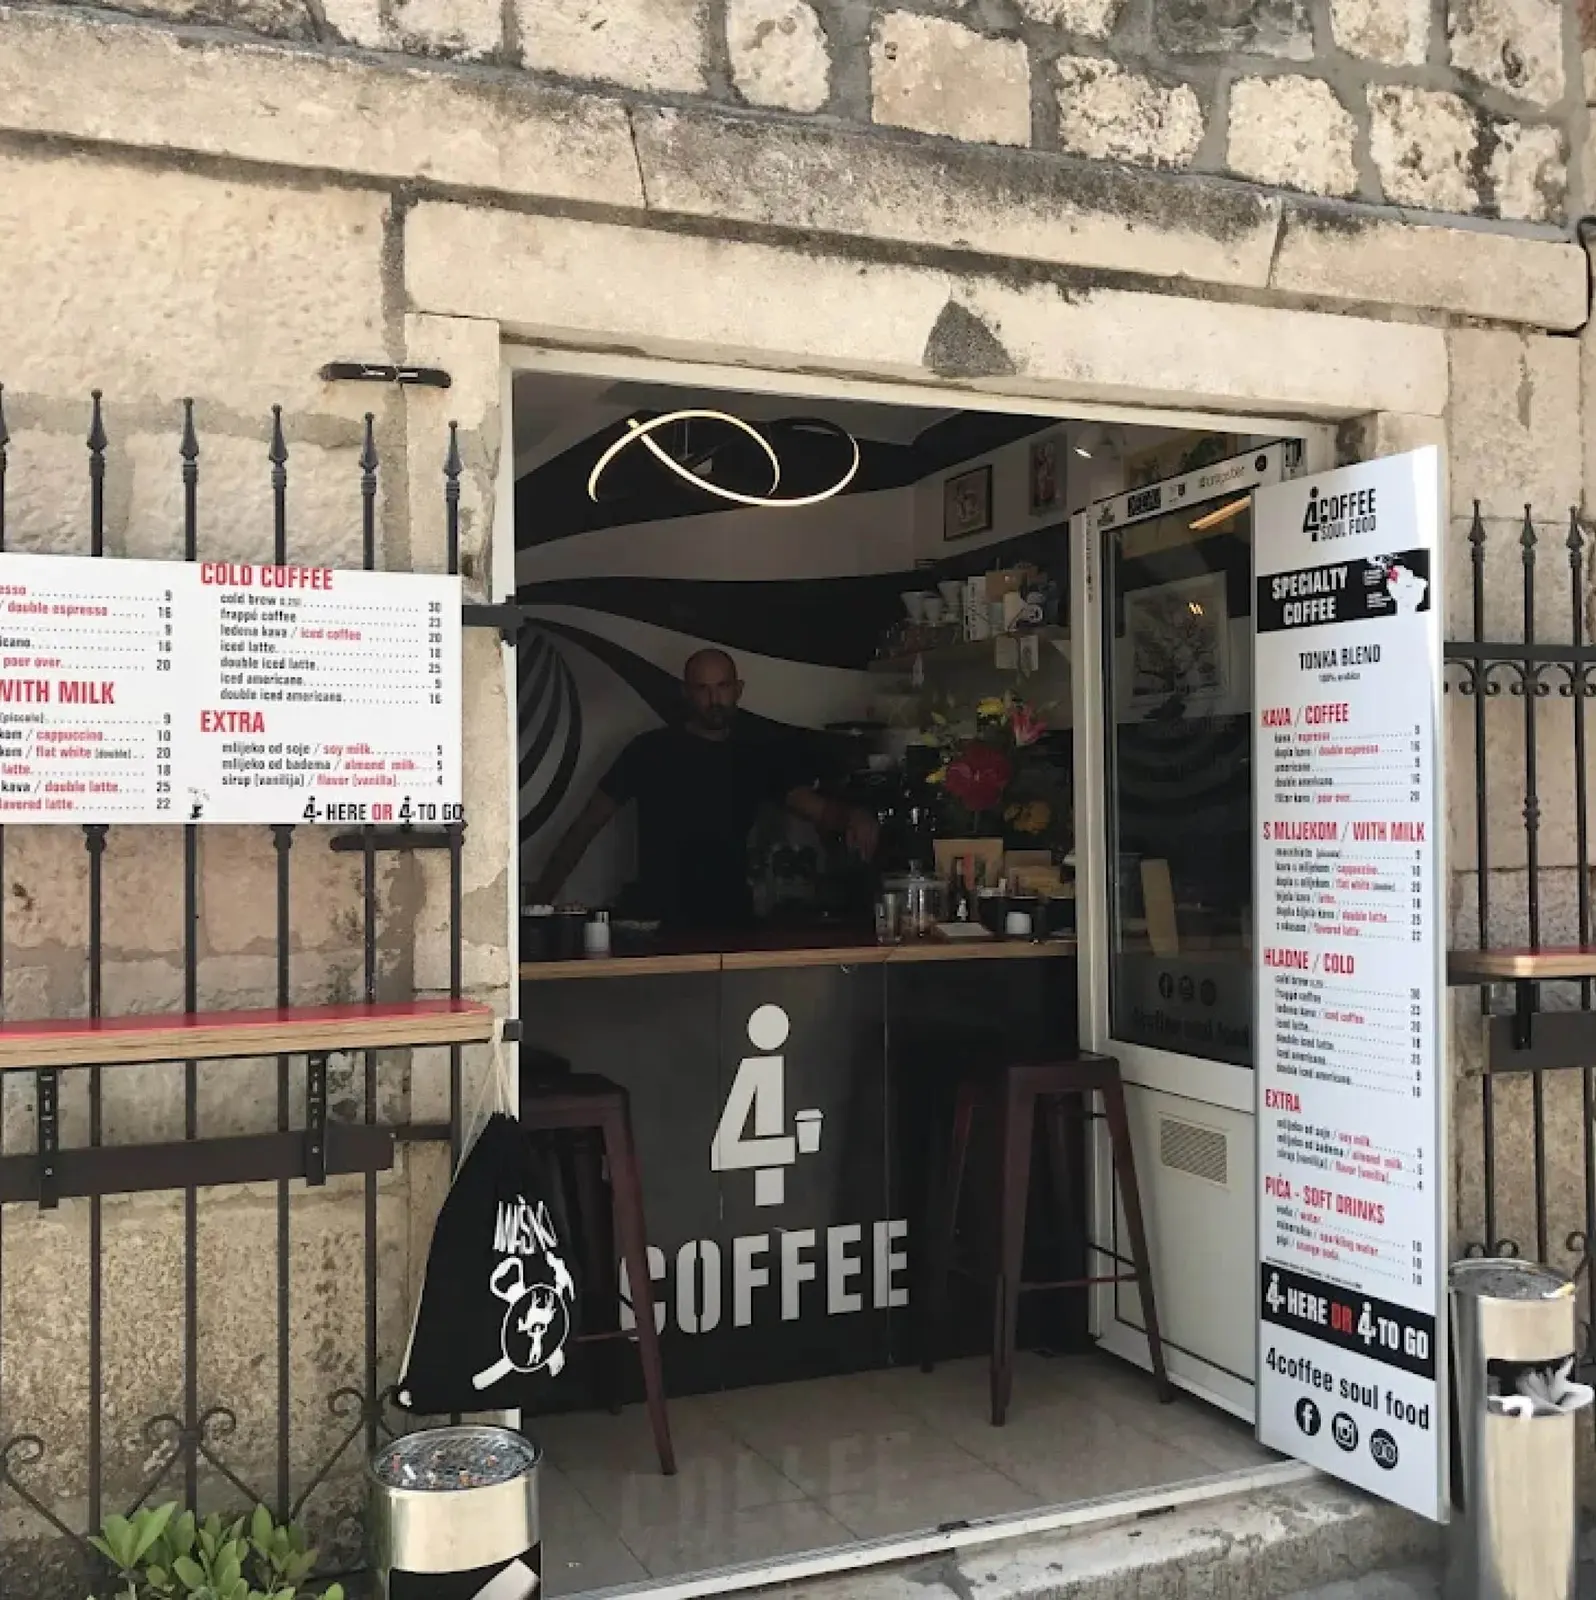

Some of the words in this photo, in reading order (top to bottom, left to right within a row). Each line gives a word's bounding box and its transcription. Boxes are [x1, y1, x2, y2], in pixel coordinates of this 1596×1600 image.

[1320, 488, 1376, 523] COFFEE
[1320, 521, 1347, 541] SOUL
[1349, 514, 1376, 535] FOOD
[200, 562, 252, 586] COLD
[261, 565, 334, 590] COFFEE
[1271, 566, 1348, 600] SPECIALTY
[220, 592, 245, 604] cold
[248, 594, 276, 605] brew
[8, 600, 48, 614] double
[52, 604, 107, 618] espresso
[262, 610, 296, 623] coffee
[1283, 596, 1337, 626] COFFEE
[262, 625, 287, 638] kava
[301, 627, 324, 639] iced
[327, 628, 361, 641] coffee
[220, 640, 245, 652] iced
[249, 641, 276, 653] latte
[3, 657, 31, 669] pour
[34, 657, 61, 669] over
[156, 659, 171, 671] 20
[220, 656, 259, 669] double
[262, 657, 285, 669] iced
[288, 657, 315, 671] latte
[1299, 648, 1337, 671] TONKA
[1341, 643, 1381, 666] BLEND
[220, 672, 243, 684] iced
[247, 673, 302, 686] americano
[58, 681, 115, 704] MILK
[220, 688, 257, 700] double
[260, 688, 283, 700] iced
[286, 689, 341, 702] americano
[200, 710, 265, 733] EXTRA
[1261, 707, 1291, 728] KAVA
[1304, 703, 1350, 724] COFFEE
[37, 730, 103, 743] cappuccino
[157, 730, 171, 741] 10
[36, 744, 56, 757] flat
[60, 745, 91, 758] white
[156, 747, 171, 758] 20
[221, 741, 265, 756] mlijeko
[268, 742, 283, 753] od
[286, 743, 311, 757] soje
[322, 745, 343, 757] soy
[345, 743, 371, 754] milk
[2, 763, 30, 775] latte
[157, 765, 171, 776] 18
[221, 758, 265, 772] mlijeko
[268, 758, 283, 770] od
[286, 758, 331, 771] badema
[344, 759, 386, 771] almond
[391, 759, 415, 771] milk
[1, 780, 30, 792] kava
[45, 780, 85, 792] double
[89, 780, 118, 793] latte
[156, 782, 171, 793] 25
[221, 774, 251, 788] sirup
[316, 774, 350, 786] flavor
[436, 775, 443, 786] 4
[45, 798, 72, 810] latte
[156, 797, 171, 808] 22
[326, 803, 367, 821] HERE
[371, 803, 393, 821] OR
[417, 803, 436, 821] TO
[442, 803, 463, 822] GO
[1263, 821, 1271, 840] S
[1274, 821, 1337, 840] MLIJEKOM
[1353, 821, 1387, 841] WITH
[1390, 821, 1425, 842] MILK
[1263, 947, 1309, 970] HLADNE
[1323, 952, 1355, 974] COLD
[1264, 1088, 1302, 1113] EXTRA
[1264, 1172, 1292, 1200] PIĆA
[1302, 1184, 1333, 1211] SOFT
[1335, 1193, 1385, 1225] DRINKS
[619, 1218, 909, 1341] COFFEE
[1287, 1287, 1329, 1325] HERE
[1331, 1301, 1353, 1335] OR
[1377, 1317, 1399, 1350] TO
[1403, 1325, 1429, 1360] GO
[1265, 1347, 1333, 1393] 4coffee
[1339, 1377, 1379, 1411] soul
[1385, 1390, 1429, 1430] food
